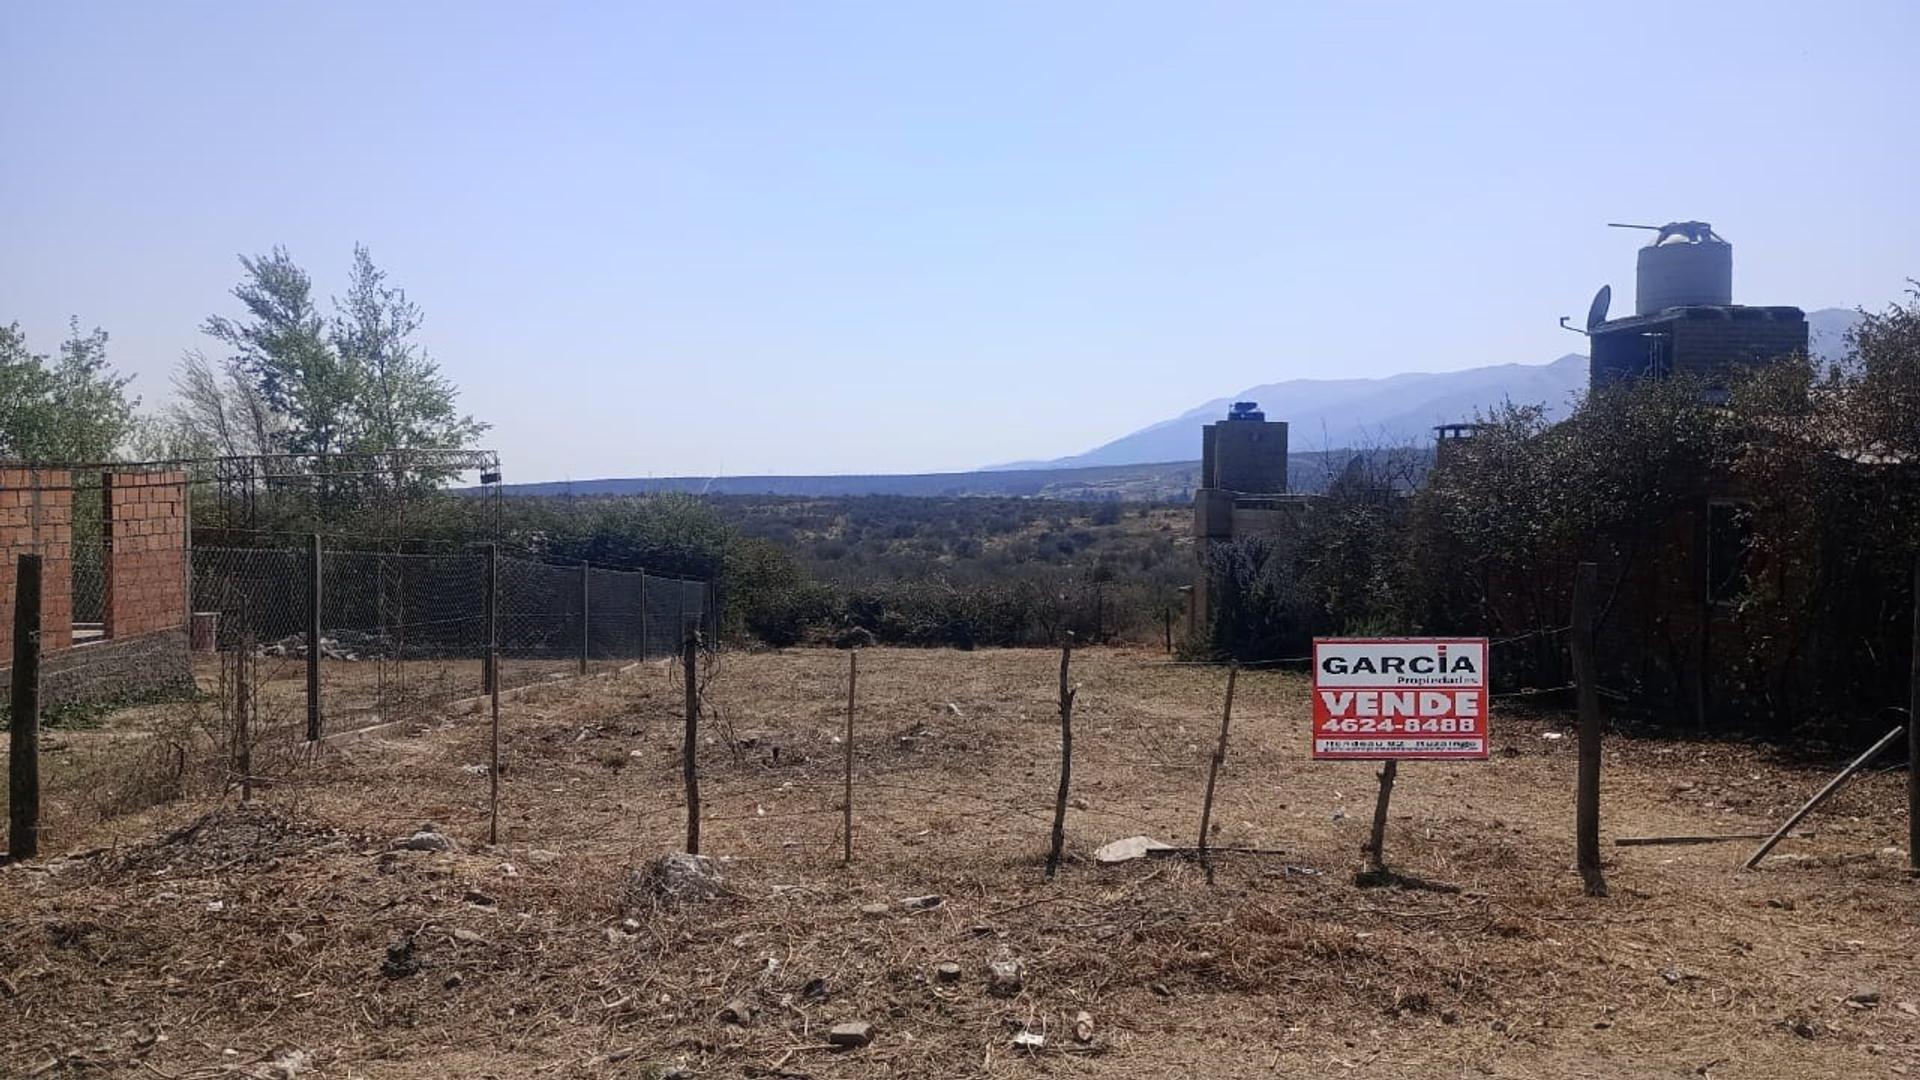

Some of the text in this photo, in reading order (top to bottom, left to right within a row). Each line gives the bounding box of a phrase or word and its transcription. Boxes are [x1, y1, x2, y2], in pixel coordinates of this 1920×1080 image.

[1397, 675, 1478, 685] Propiedades
[1320, 691, 1479, 717] VENDE
[1321, 718, 1475, 733] 4624-8488
